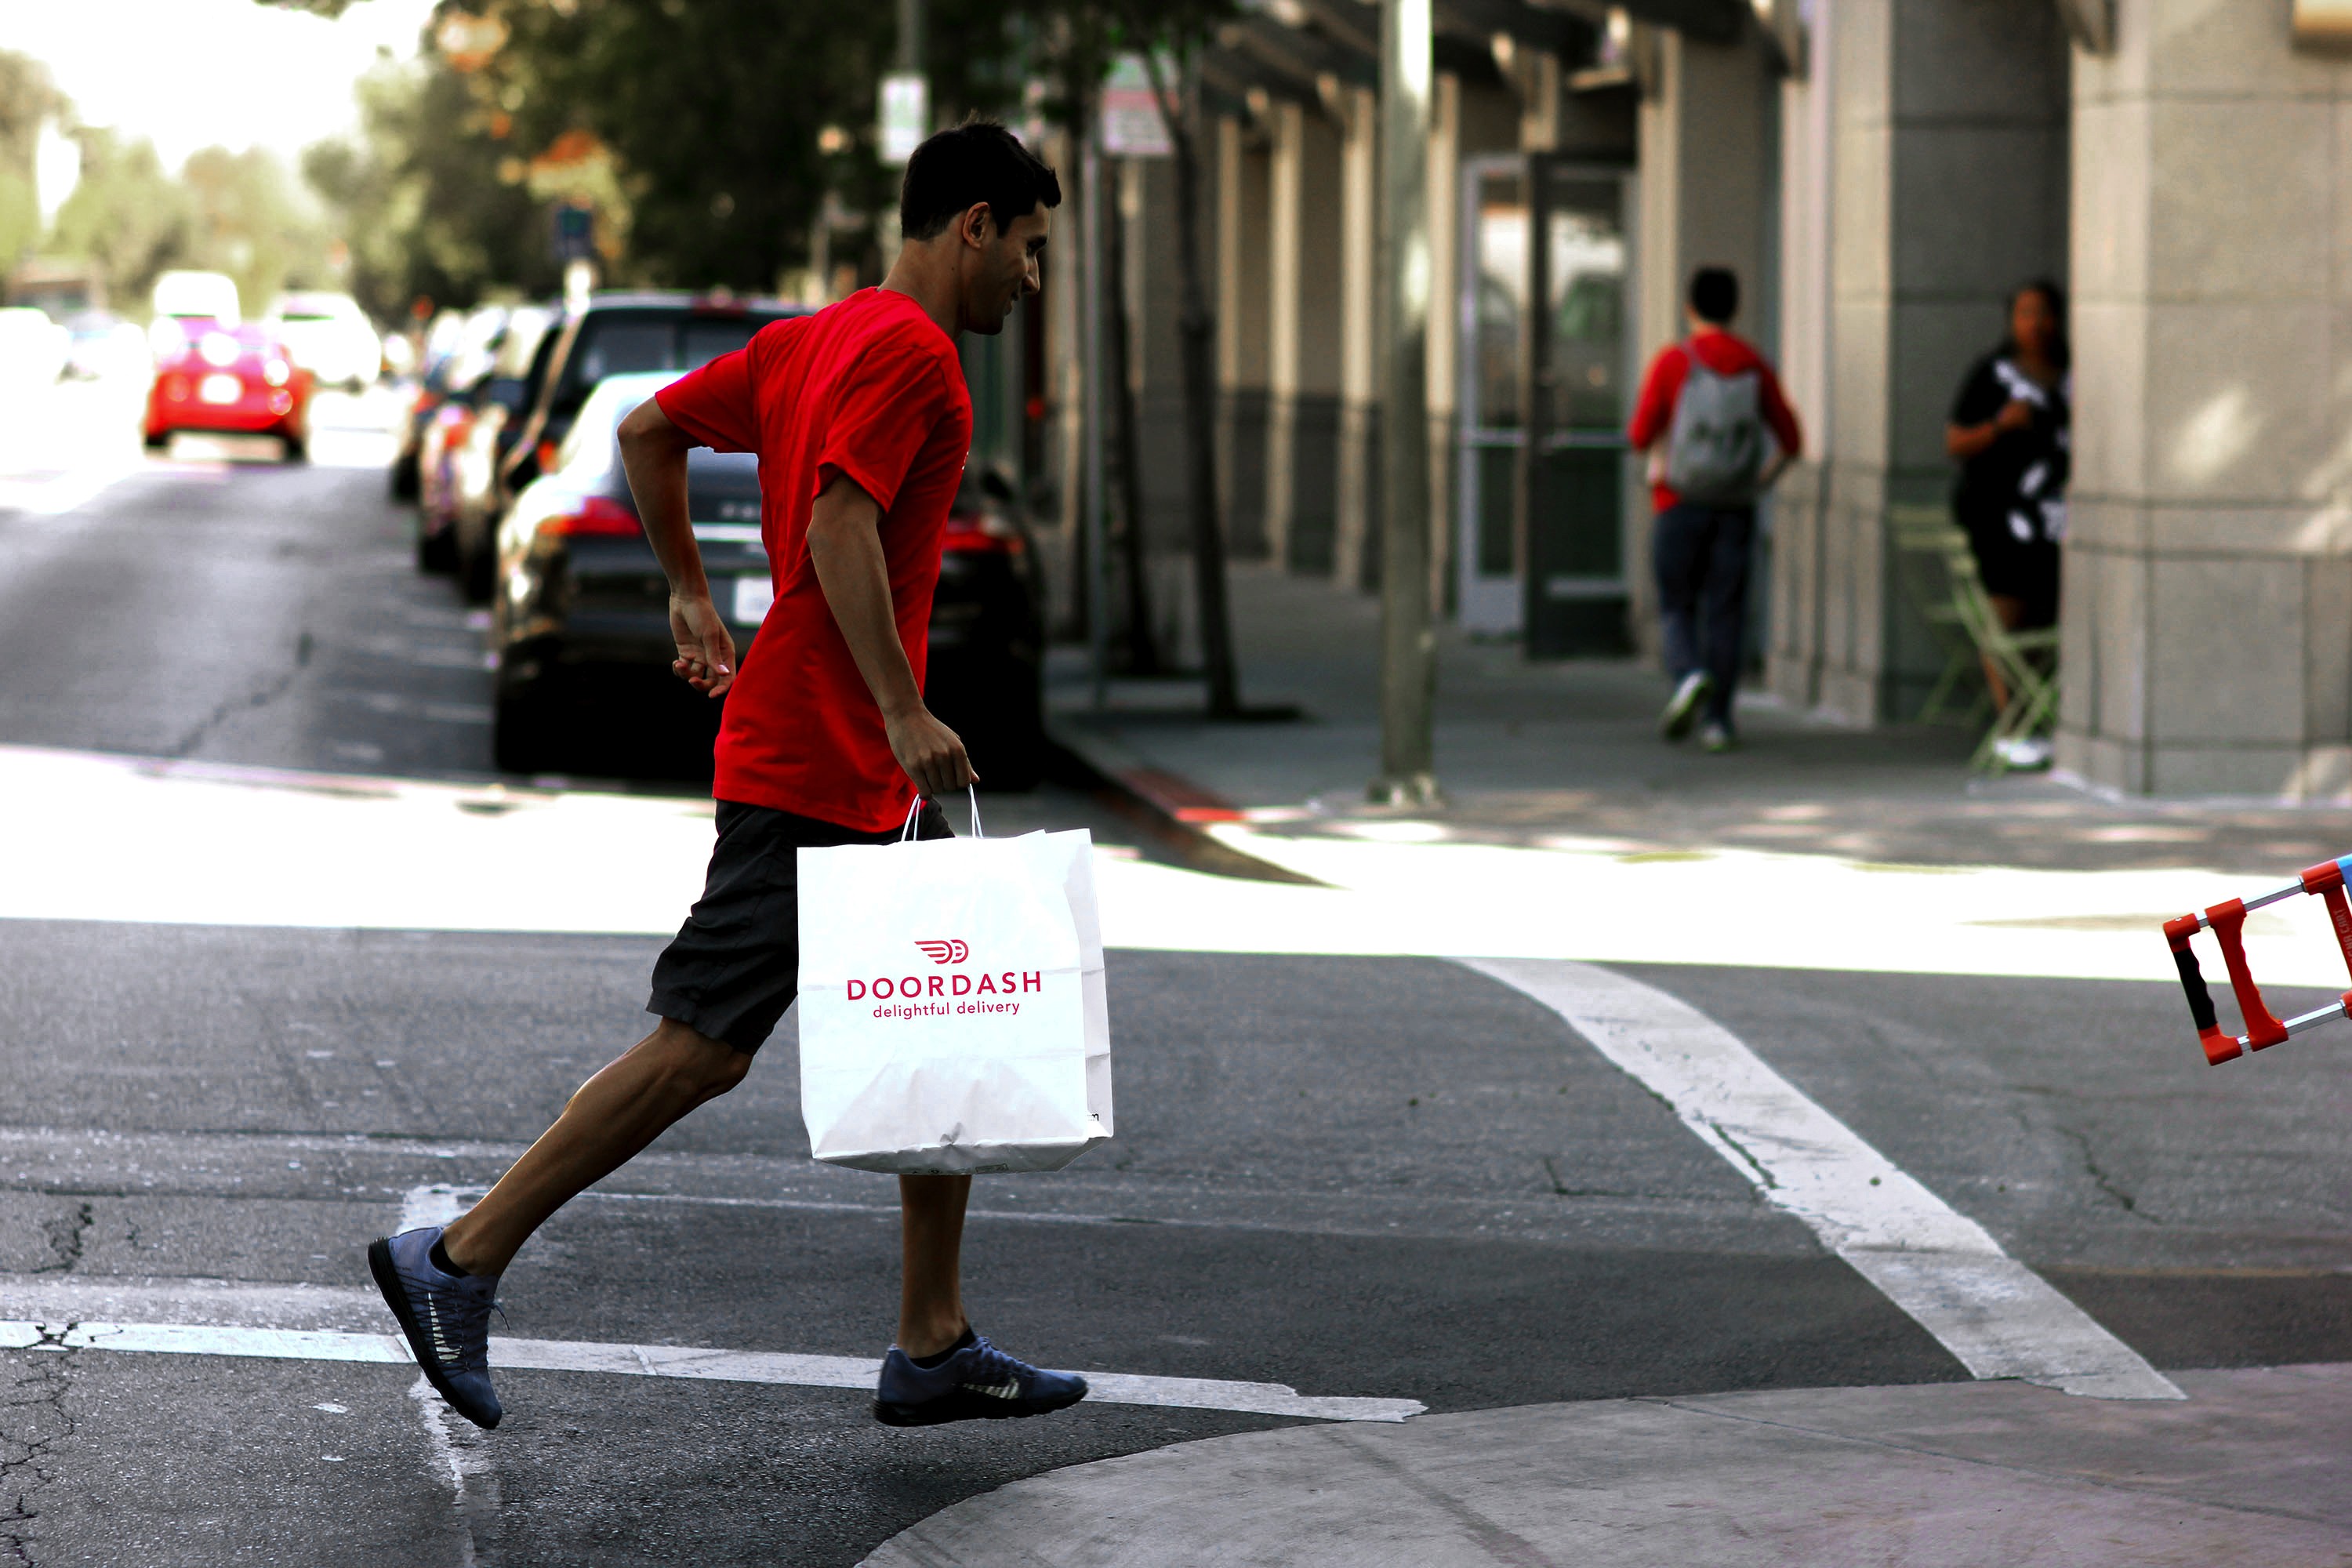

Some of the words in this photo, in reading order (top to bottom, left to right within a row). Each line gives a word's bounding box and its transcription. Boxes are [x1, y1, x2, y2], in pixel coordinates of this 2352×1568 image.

[2332, 908, 2350, 934] CART
[847, 971, 1042, 1001] DOORDASH
[873, 1001, 950, 1020] delightful
[956, 1000, 1020, 1015] delivery
